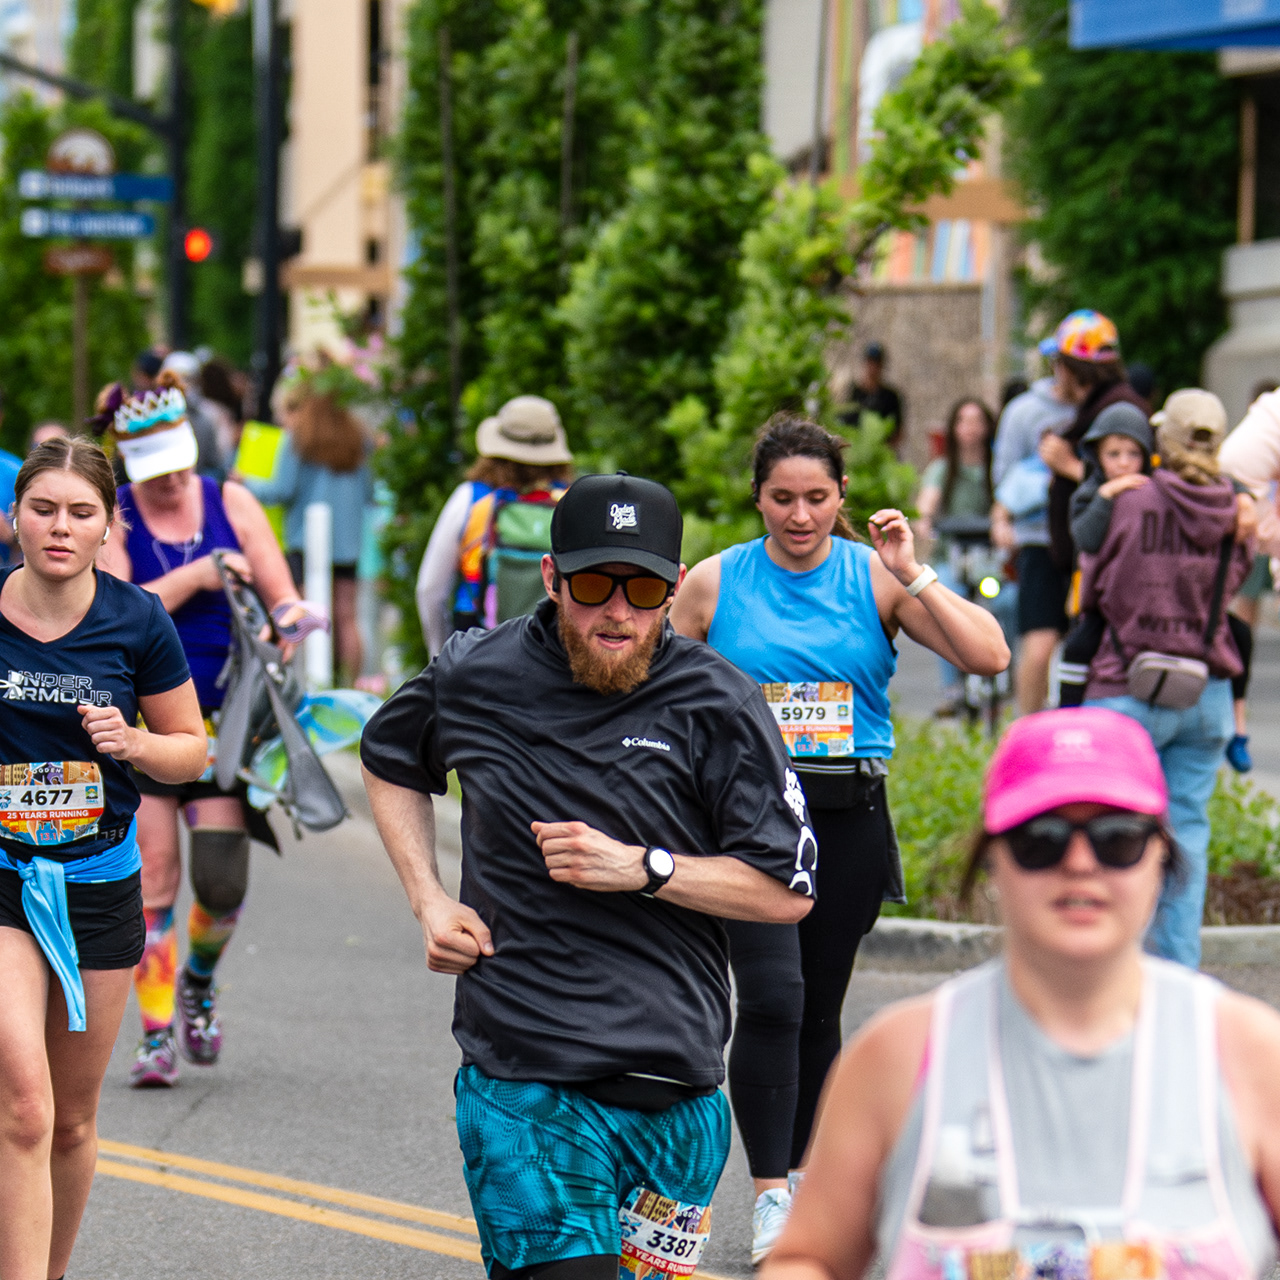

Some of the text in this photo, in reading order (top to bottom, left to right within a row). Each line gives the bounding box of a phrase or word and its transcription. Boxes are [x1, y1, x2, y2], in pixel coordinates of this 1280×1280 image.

[8, 669, 93, 690] UNDER
[3, 683, 113, 707] ARMOUR
[781, 706, 826, 721] 5979
[631, 737, 671, 752] Columbia
[19, 788, 73, 806] 4677
[7, 809, 89, 820] 25 YEARS RUNNING
[40, 832, 57, 841] 13.1
[646, 1230, 698, 1258] 3387
[622, 1242, 634, 1254] 25
[634, 1249, 668, 1269] YEARS
